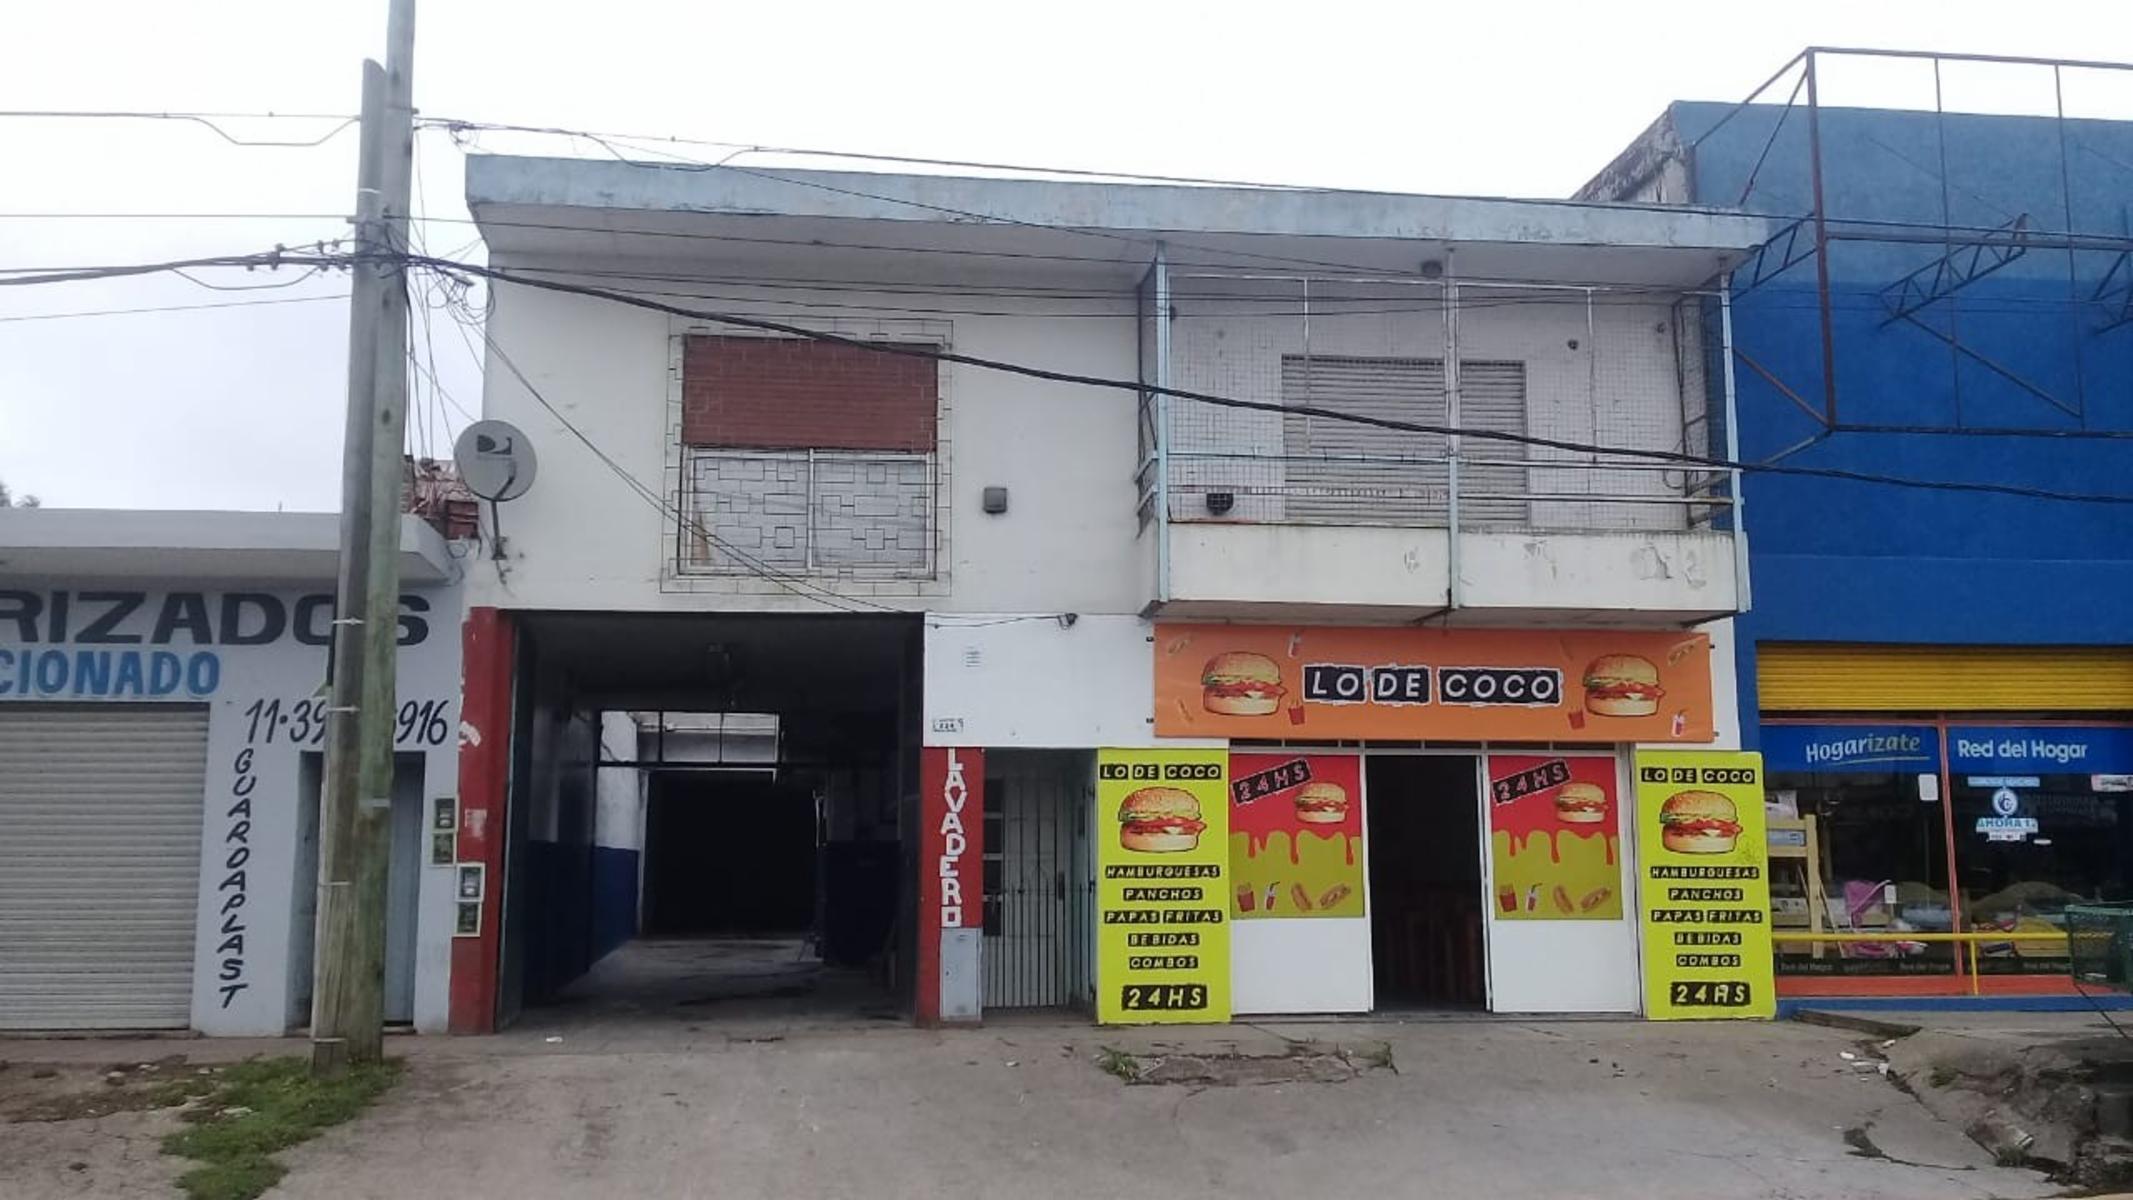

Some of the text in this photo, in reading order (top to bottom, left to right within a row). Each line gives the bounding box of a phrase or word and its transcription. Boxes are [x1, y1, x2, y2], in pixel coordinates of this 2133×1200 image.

[1312, 671, 1554, 698] LO DE COCO
[1805, 733, 1921, 763] Hogarizate
[1957, 739, 2088, 763] Red del Hogar
[1103, 766, 1220, 778] LO DE COCO
[1644, 769, 1754, 783] LO DE COCO
[1106, 866, 1218, 877] HAMBURGUESAS
[1652, 868, 1757, 878] HAMBURGUESAS
[1125, 889, 1200, 900] PANCHOS
[1670, 890, 1741, 900] PANCHOS
[1106, 911, 1219, 922] PAPAS FRITAS
[1653, 911, 1760, 922] PAPAS FRITAS
[1130, 934, 1197, 945] BEBIDAS
[1676, 933, 1739, 944] BEBIDAS
[1131, 957, 1196, 968] COMBOS
[1678, 955, 1739, 966] COMBOS
[1128, 987, 1201, 1008] 24HS
